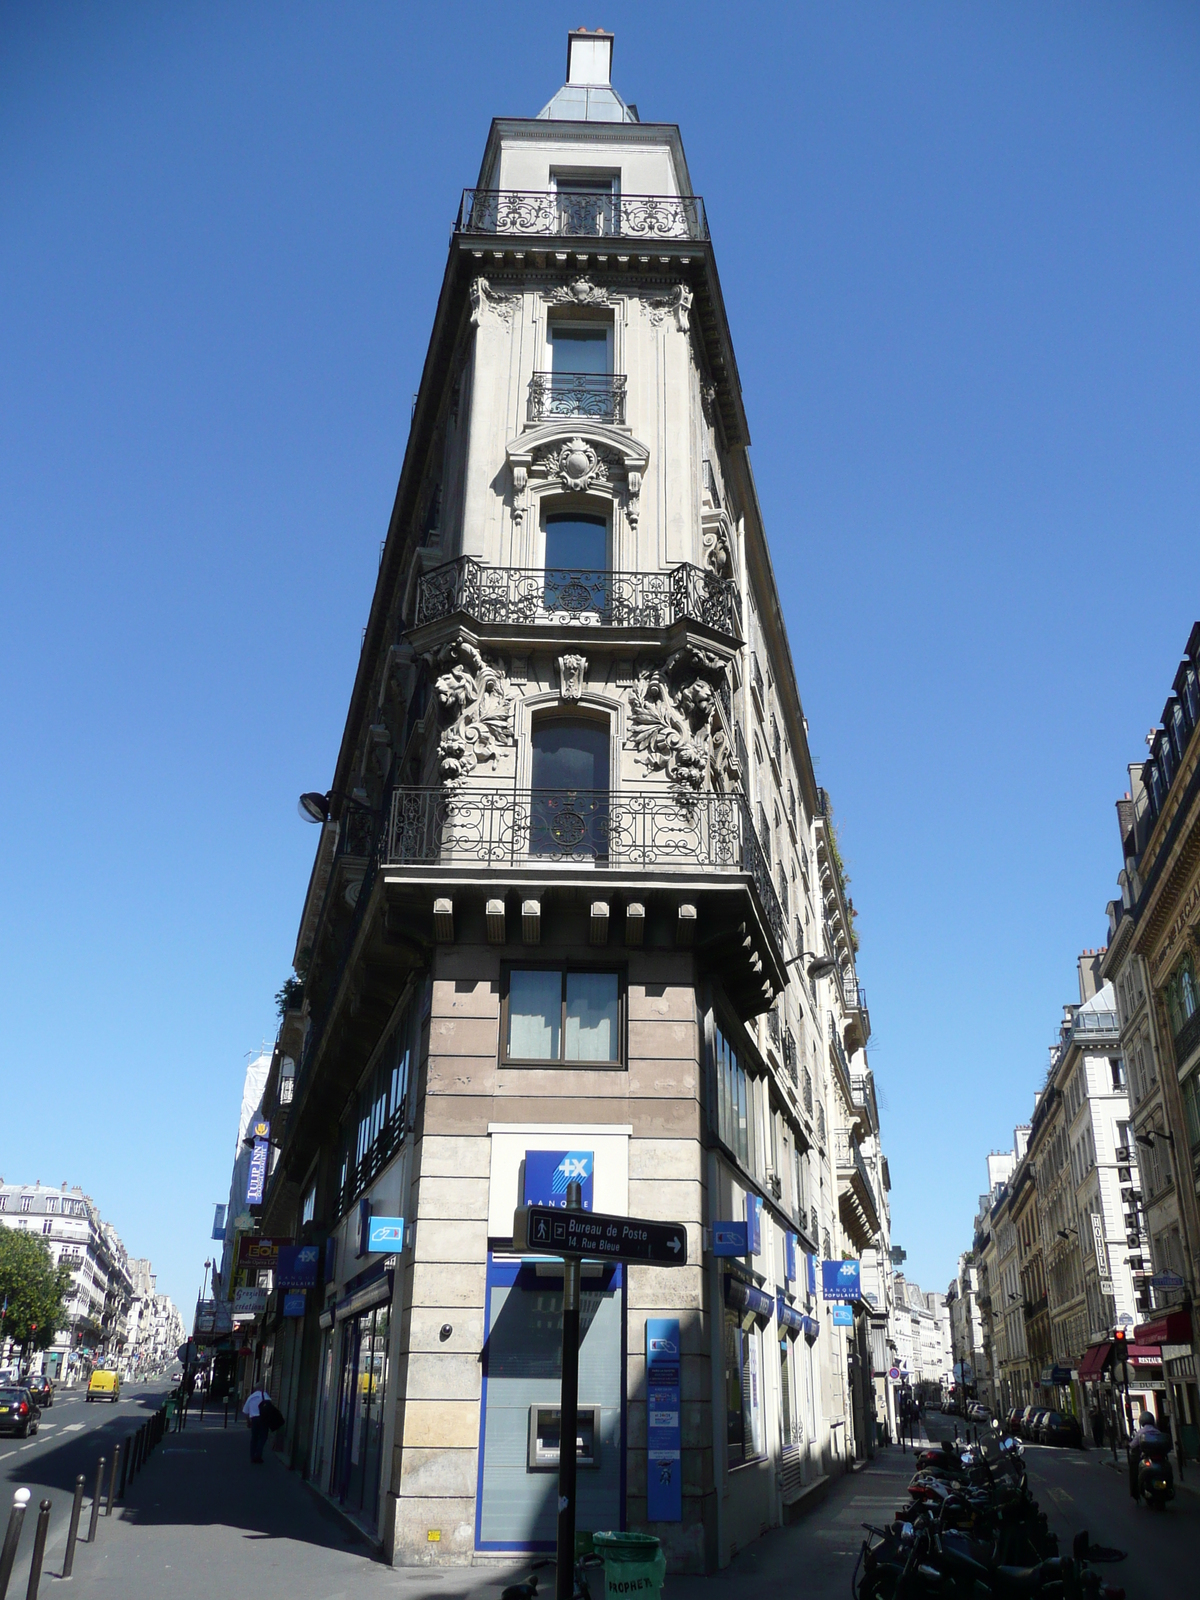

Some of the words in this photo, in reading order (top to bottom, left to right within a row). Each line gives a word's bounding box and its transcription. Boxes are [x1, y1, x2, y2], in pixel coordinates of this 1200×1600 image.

[251, 1145, 264, 1165] INN
[247, 1167, 260, 1200] TULIP
[1116, 1147, 1133, 1202] PAX
[527, 1200, 589, 1208] BANQE
[568, 1219, 602, 1235] Bureau
[606, 1224, 617, 1237] de
[622, 1225, 648, 1241] Poste
[581, 1237, 597, 1250] Rue
[599, 1239, 620, 1252] Bleue
[1125, 1213, 1149, 1312] HOTEL
